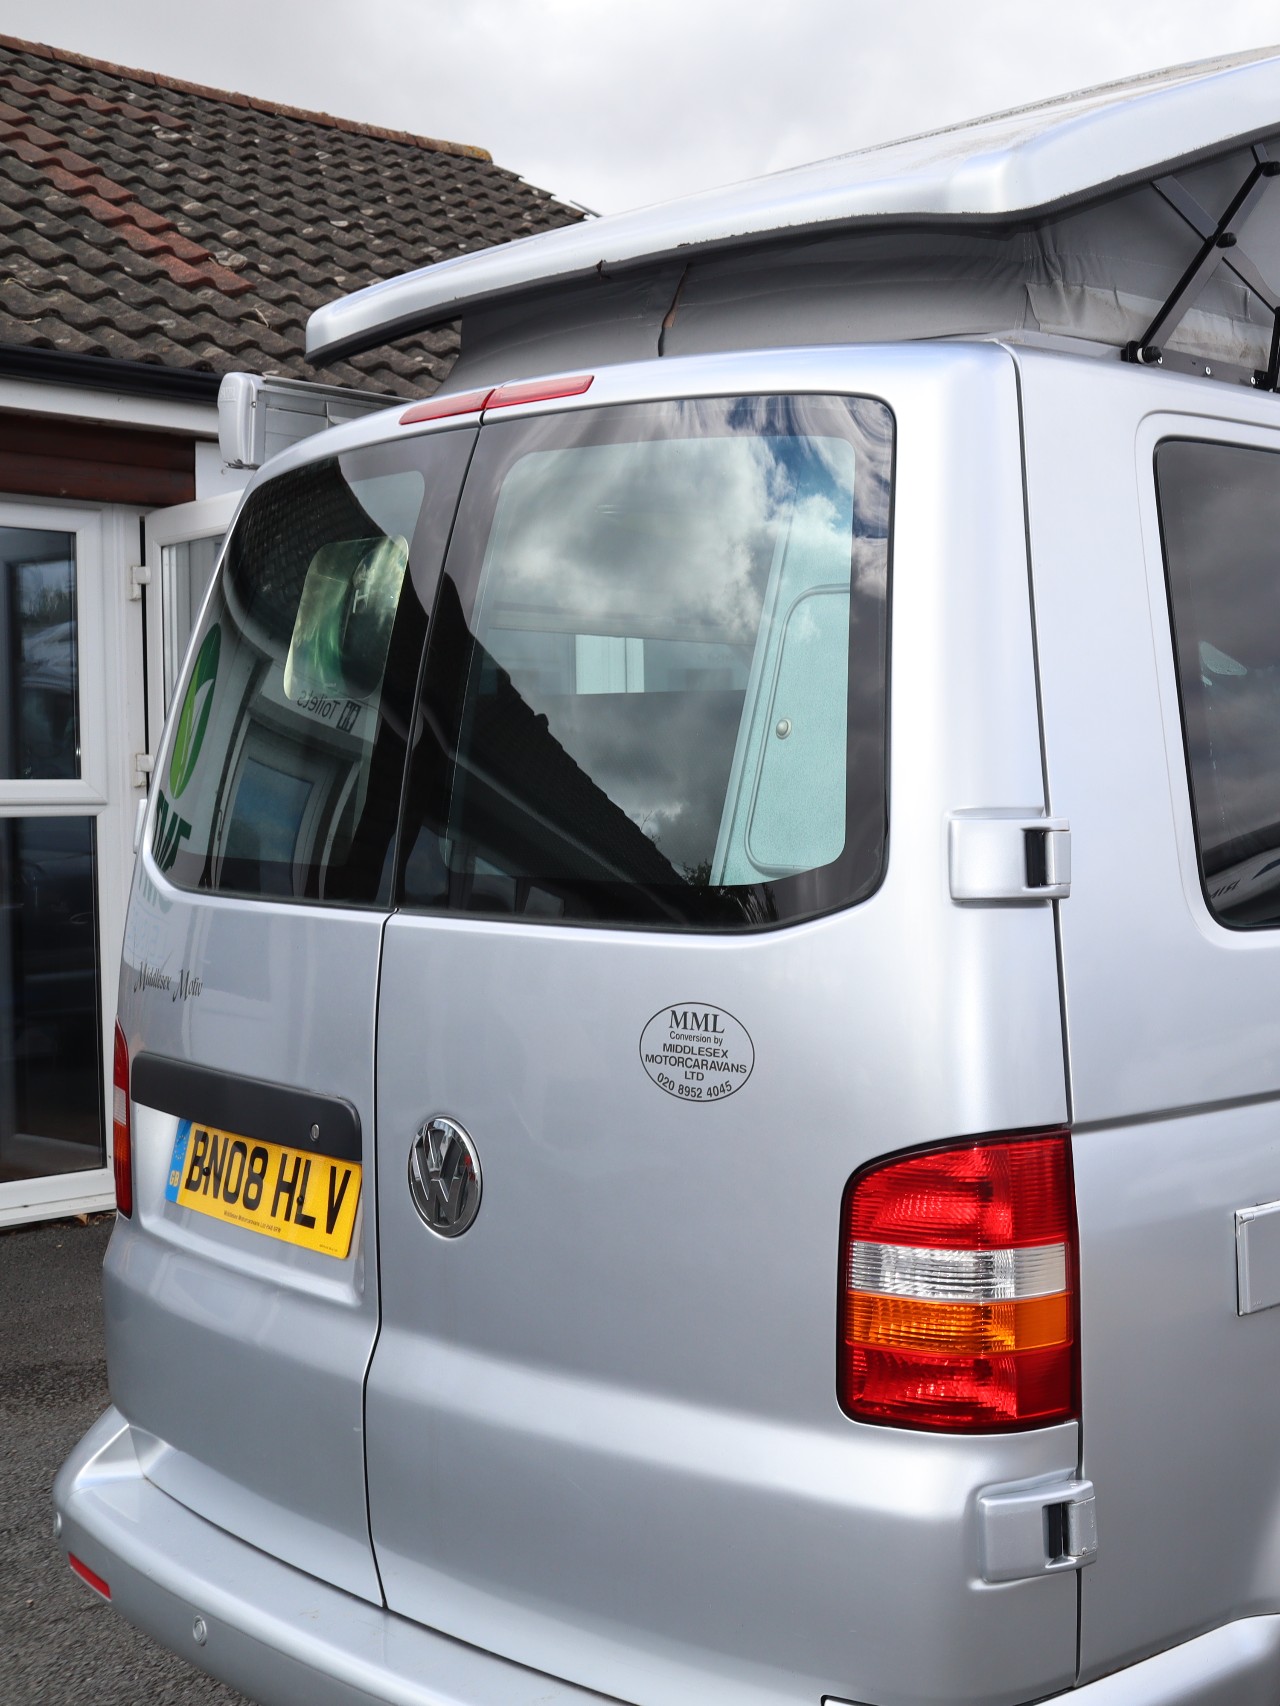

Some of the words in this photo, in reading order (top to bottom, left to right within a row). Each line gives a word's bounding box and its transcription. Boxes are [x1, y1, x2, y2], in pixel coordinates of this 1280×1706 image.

[669, 1010, 725, 1034] MML
[669, 1031, 712, 1044] Conversion
[713, 1035, 723, 1047] by
[662, 1043, 729, 1059] MIDDLESEX
[645, 1054, 747, 1074] MOTORCARAVANS
[657, 1072, 675, 1091] 020
[678, 1084, 703, 1099] 8952
[706, 1080, 732, 1098] 4045
[684, 1070, 704, 1082] LTD
[169, 1169, 180, 1187] GB
[185, 1129, 269, 1211] BN08
[270, 1153, 352, 1235] HLV
